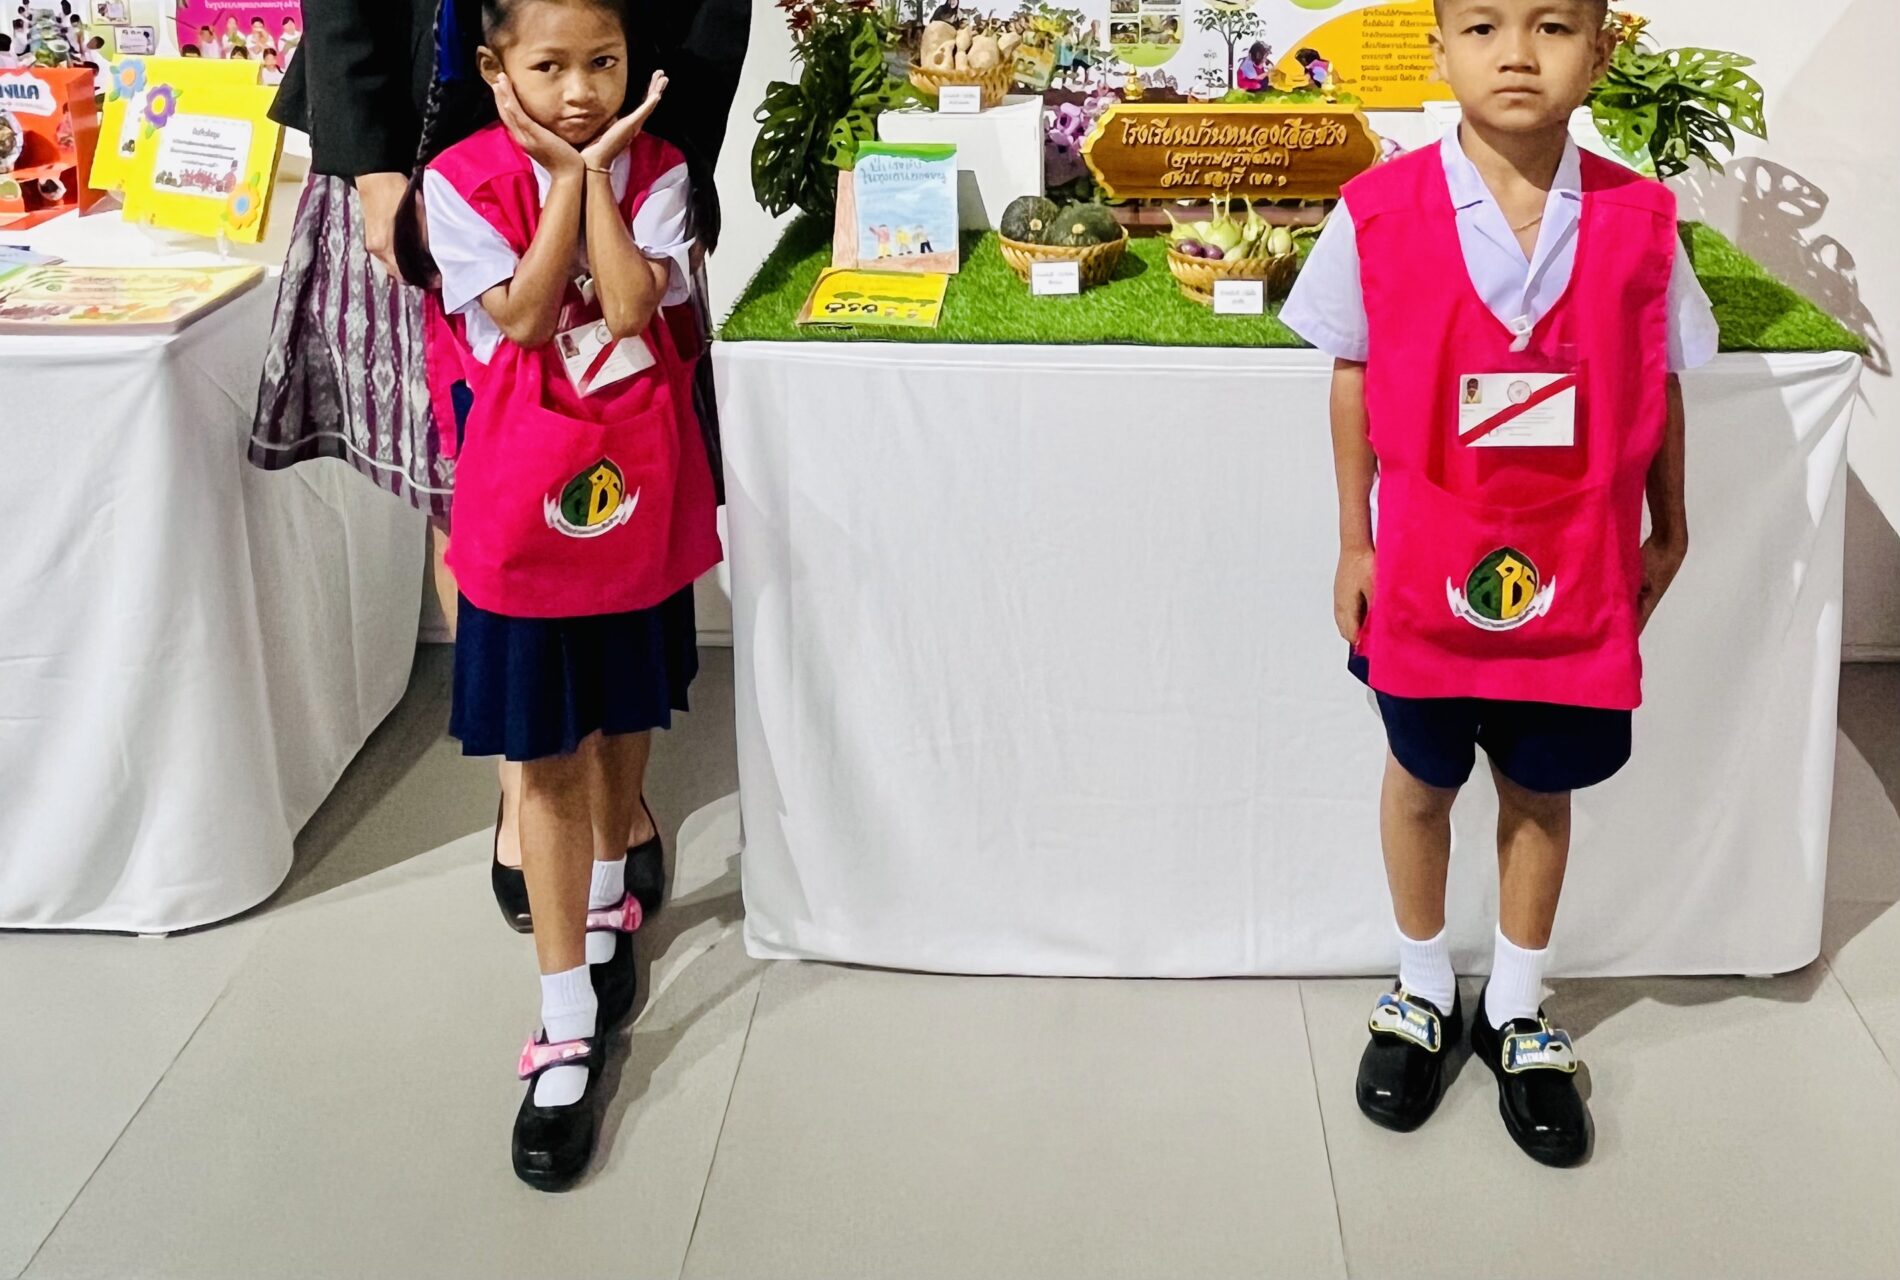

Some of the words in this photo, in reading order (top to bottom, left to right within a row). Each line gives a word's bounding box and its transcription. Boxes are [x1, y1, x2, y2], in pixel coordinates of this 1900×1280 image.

[1120, 117, 1347, 149] โรงเรียนบ้านหนองเสือช้าง
